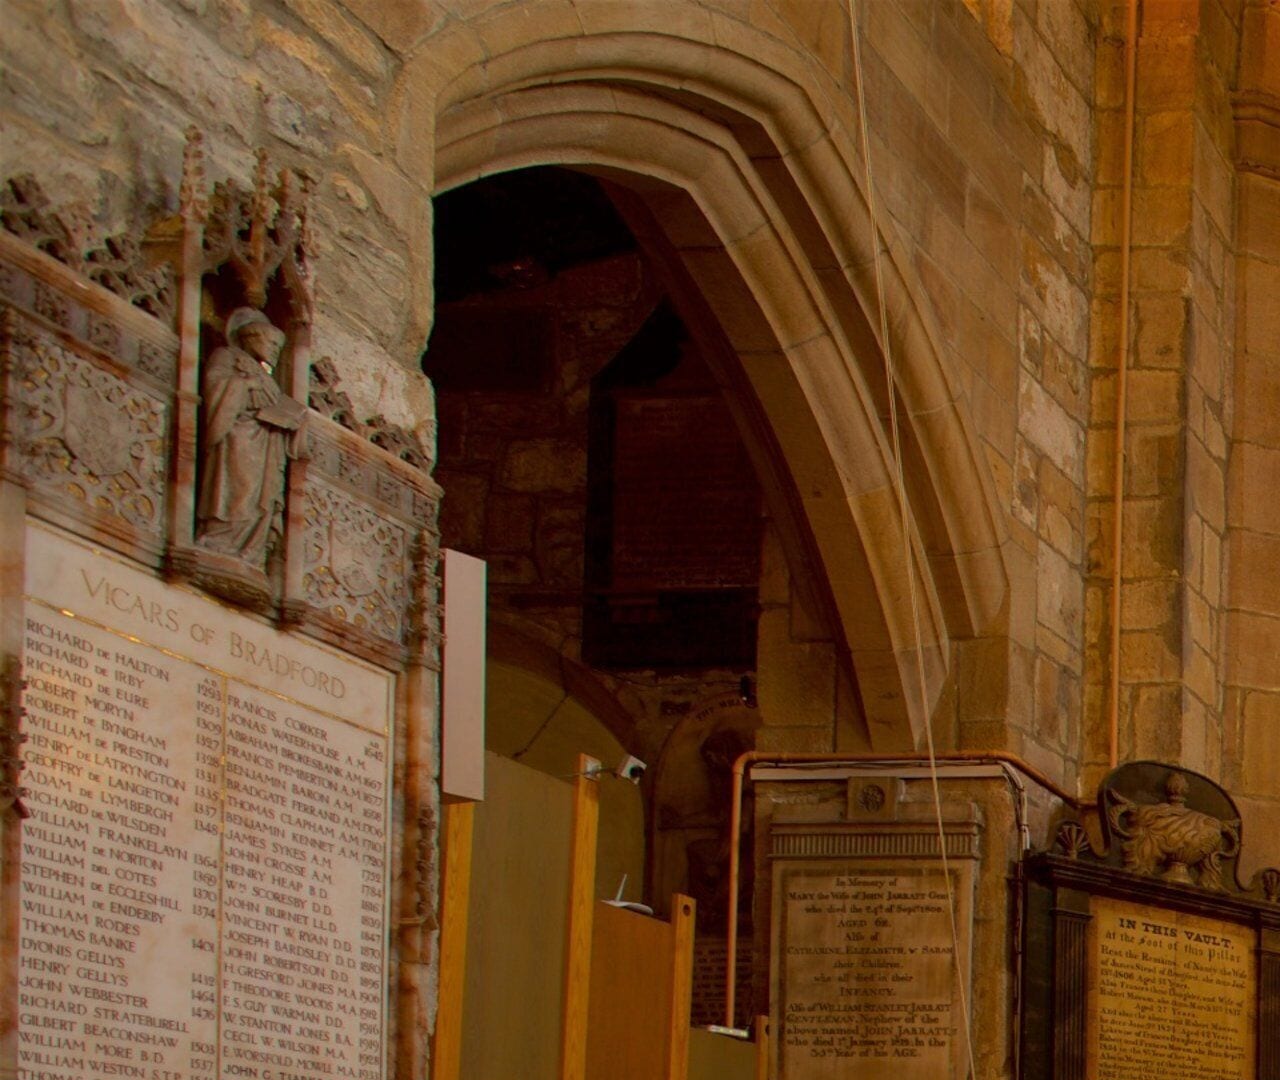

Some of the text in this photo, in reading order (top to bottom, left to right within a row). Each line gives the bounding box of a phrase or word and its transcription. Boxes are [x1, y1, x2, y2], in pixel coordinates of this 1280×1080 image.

[26, 619, 93, 655] RICHARD
[114, 651, 169, 682] HALTON
[80, 567, 346, 702] VICARS OF BRADFORD
[25, 637, 88, 671] RICHARD
[114, 669, 144, 691] IRBY
[26, 656, 92, 691] RICHARD
[115, 687, 149, 710] EURE
[195, 715, 221, 735] 1309
[25, 712, 91, 745] WILLIAM
[112, 740, 169, 769] PRESTON
[23, 825, 86, 853] WILLIAM
[109, 847, 163, 872] NORTON
[224, 845, 259, 865] JOHN
[263, 856, 306, 878] CROSSE
[22, 862, 84, 889] STEPHEN
[108, 882, 182, 912] ECCLESHILL
[192, 903, 216, 919] 1374
[1119, 917, 1137, 929] IN
[1141, 922, 1178, 937] THIS
[21, 956, 70, 977] HENRY
[20, 974, 62, 994] JOHN
[68, 983, 148, 1009] WEBBESTER
[223, 1029, 257, 1045] CECIL
[277, 1038, 319, 1056] WILSON
[239, 1015, 291, 1035] STANTON
[295, 1025, 330, 1042] JONES
[223, 1063, 257, 1079] JOHN
